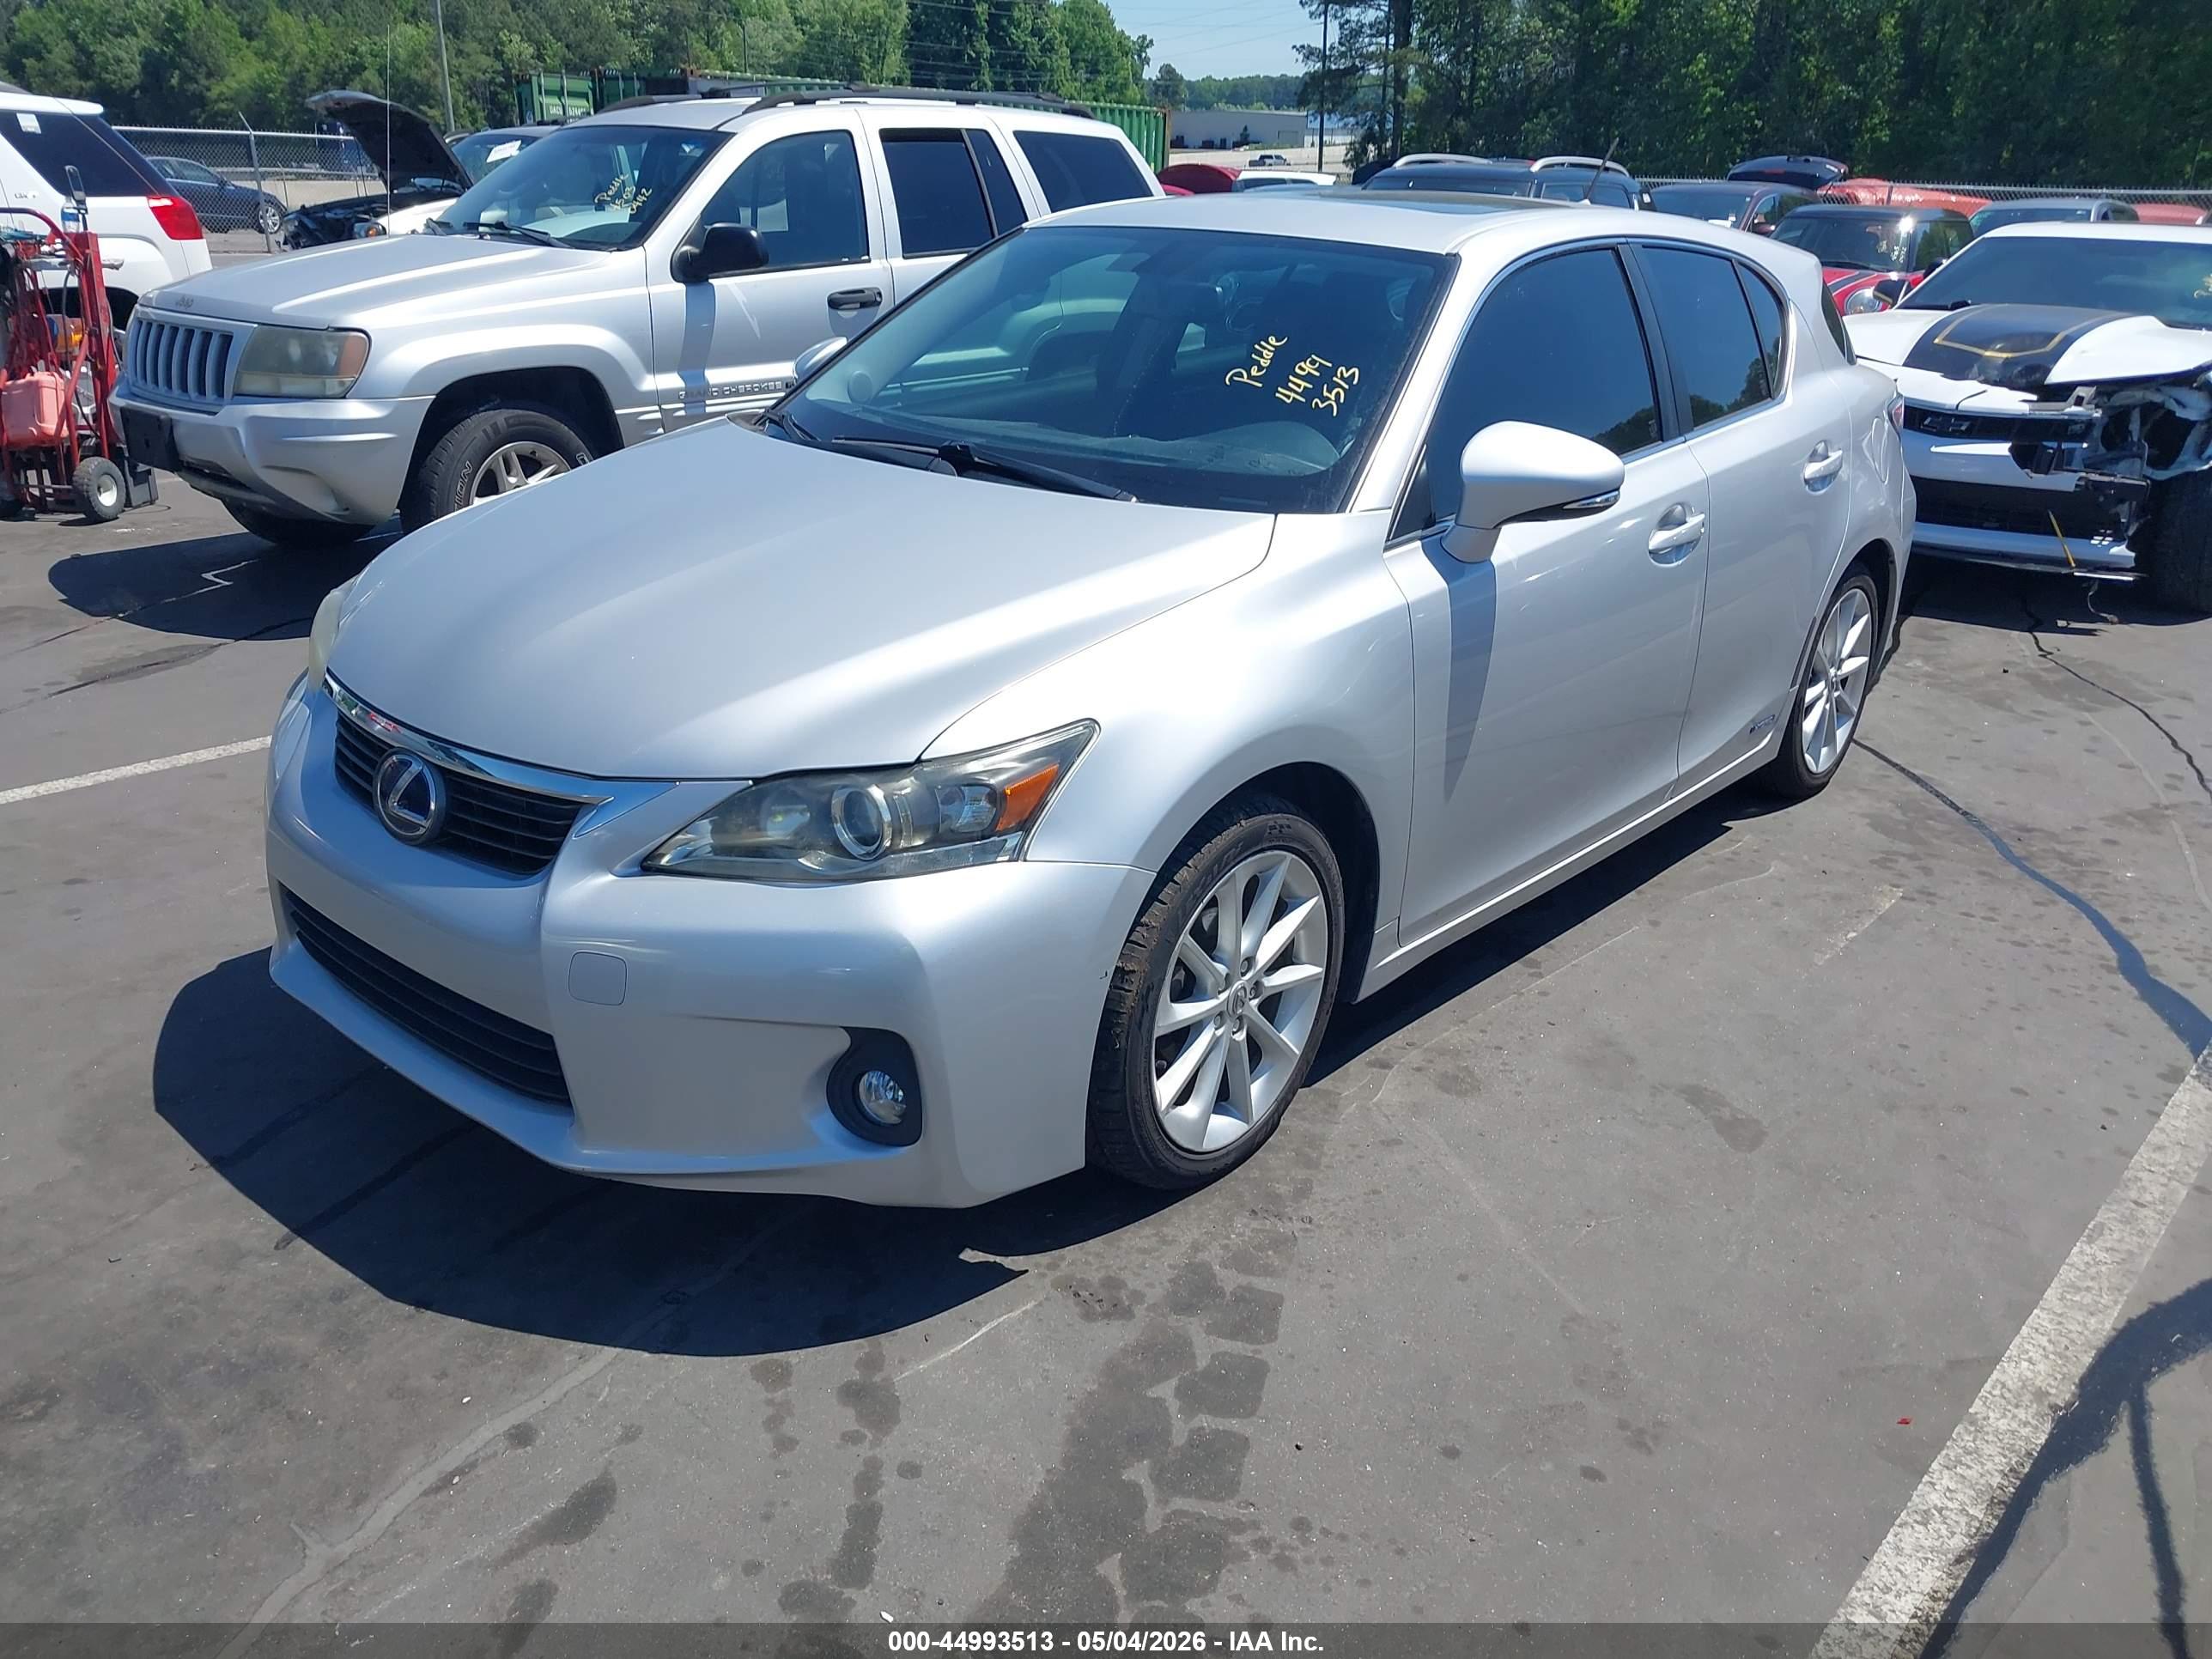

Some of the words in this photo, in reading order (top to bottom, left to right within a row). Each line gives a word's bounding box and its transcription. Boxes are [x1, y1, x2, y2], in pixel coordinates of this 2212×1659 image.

[1224, 335, 1288, 387] Peddle
[1275, 354, 1333, 404] 4499
[722, 380, 782, 396] CHEROKEE
[1311, 366, 1359, 417] 3513
